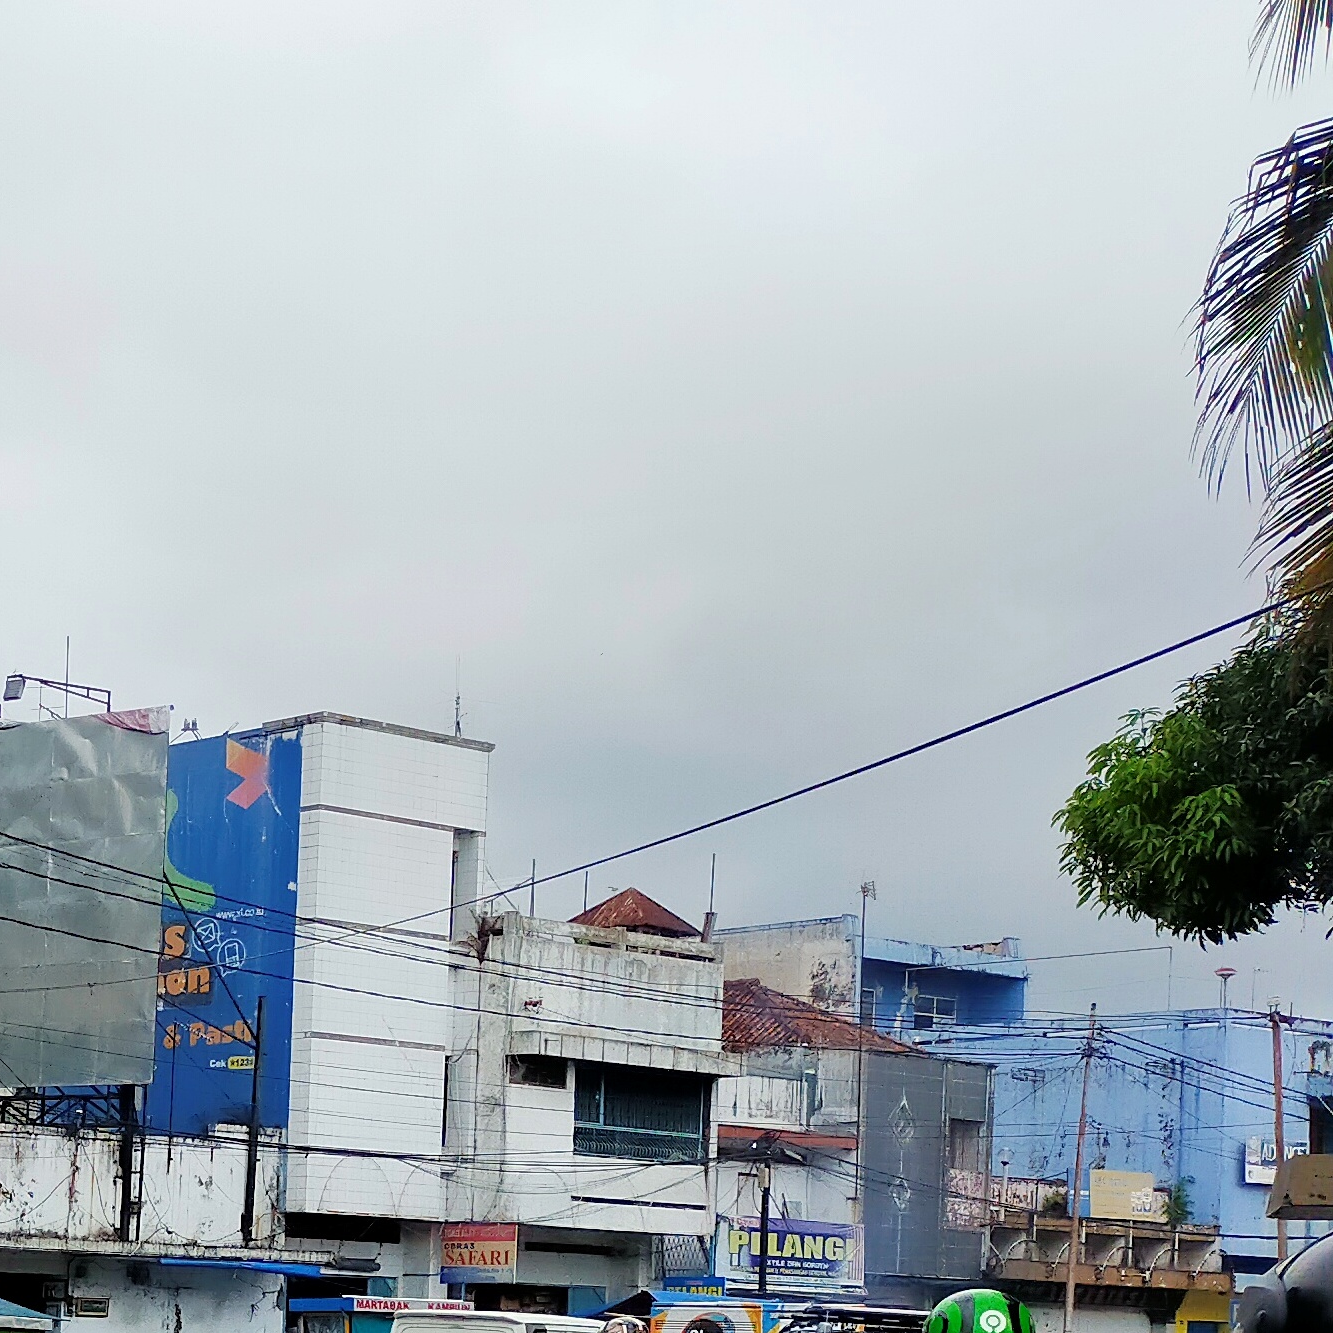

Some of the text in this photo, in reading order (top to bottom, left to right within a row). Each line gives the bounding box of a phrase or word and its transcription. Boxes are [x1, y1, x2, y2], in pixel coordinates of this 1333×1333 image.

[209, 1060, 226, 1068] Cek
[444, 1242, 475, 1250] OBRAS
[444, 1249, 510, 1265] SAFARI
[356, 1300, 410, 1311] MARTABAK
